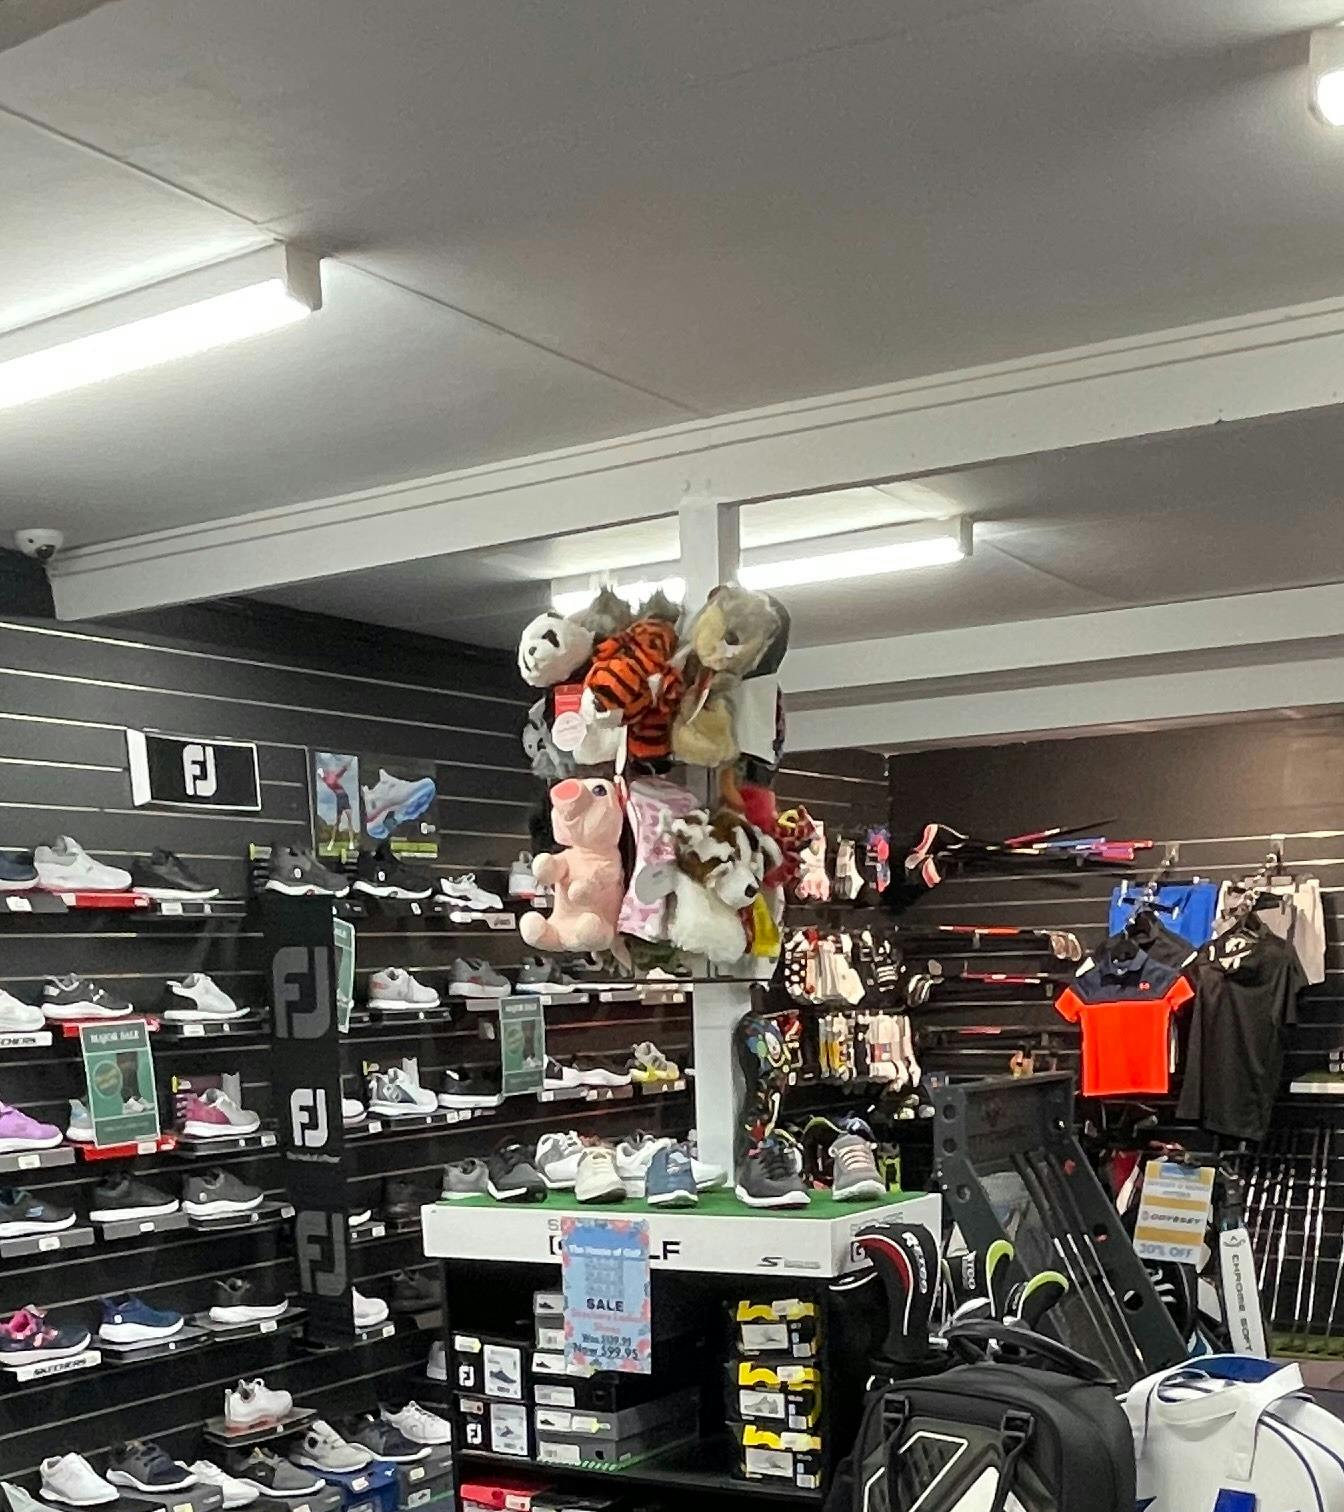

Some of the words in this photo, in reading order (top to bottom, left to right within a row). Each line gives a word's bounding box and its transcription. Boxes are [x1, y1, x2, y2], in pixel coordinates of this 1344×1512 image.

[183, 745, 216, 797] FJ
[272, 946, 328, 1039] FJ
[291, 1088, 327, 1147] FJ
[298, 1211, 346, 1295] FJ
[586, 1298, 624, 1312] SALE
